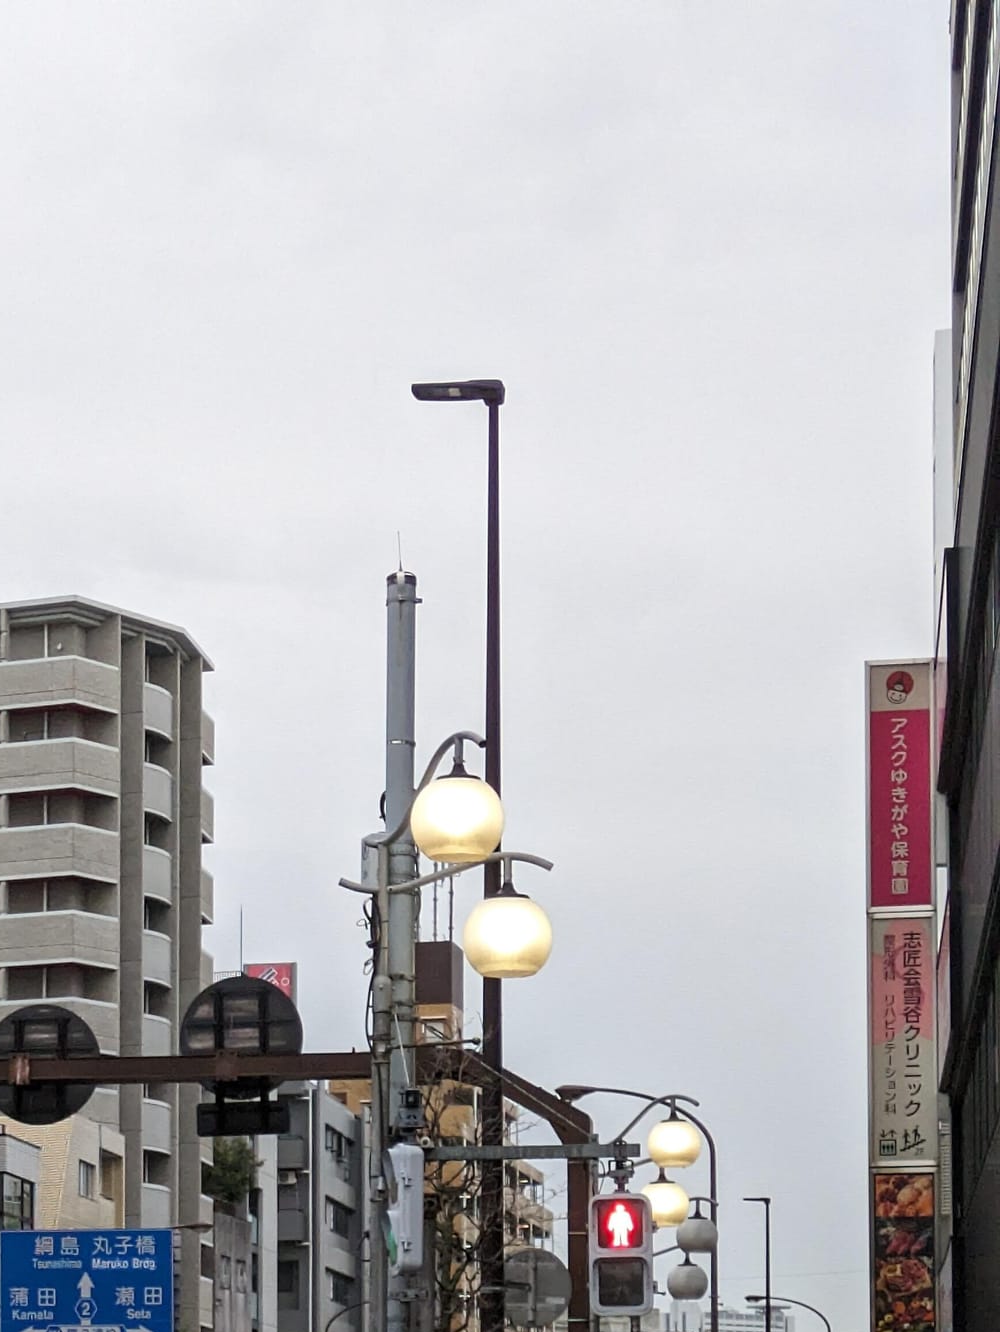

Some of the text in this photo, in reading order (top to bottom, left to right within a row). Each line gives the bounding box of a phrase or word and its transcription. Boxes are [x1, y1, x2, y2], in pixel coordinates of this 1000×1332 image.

[890, 718, 908, 894] アスクゆきがや保育園
[34, 1235, 156, 1256] 綱島 丸子橋
[32, 1258, 83, 1269] Tsunashima
[92, 1258, 129, 1269] Maruko
[9, 1287, 56, 1307] 蒲田
[114, 1286, 163, 1306] 瀬田
[12, 1309, 54, 1320] Kamata
[82, 1303, 90, 1316] 2
[126, 1308, 152, 1320] Seta
